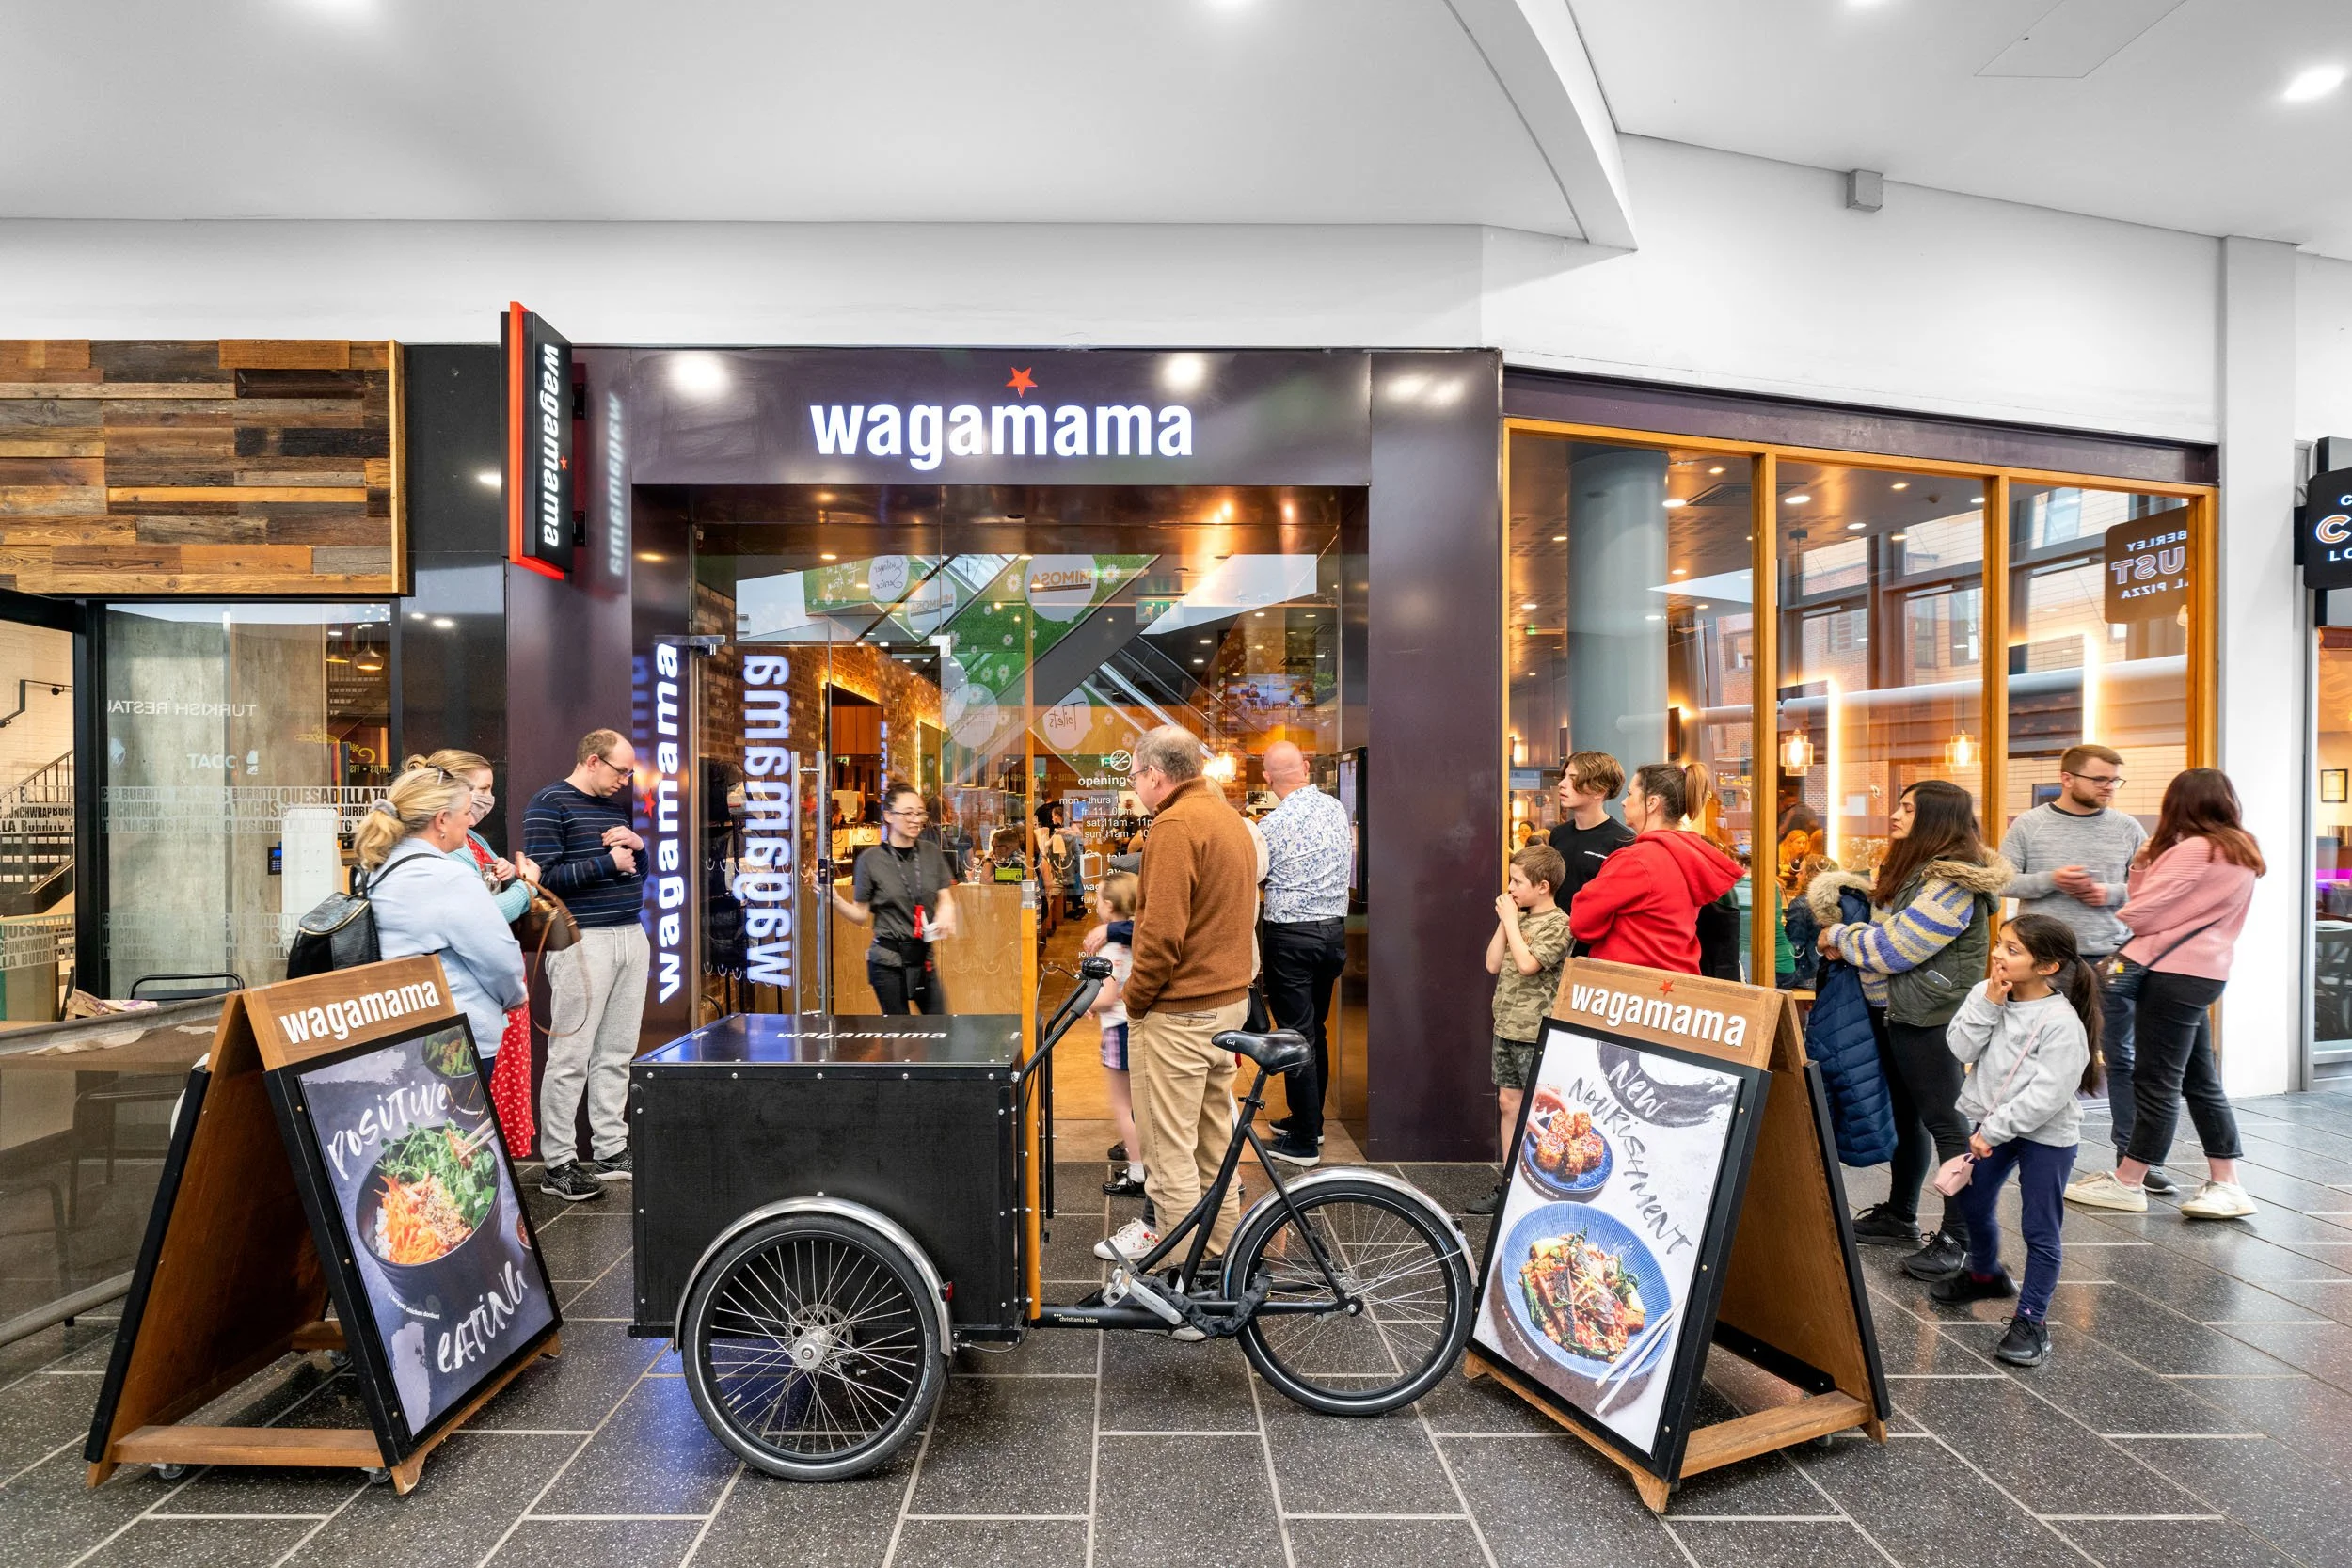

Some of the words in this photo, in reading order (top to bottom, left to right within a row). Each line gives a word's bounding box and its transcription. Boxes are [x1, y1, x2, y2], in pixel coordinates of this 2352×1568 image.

[540, 343, 559, 546] wagamama
[809, 404, 1193, 470] wagamama
[1077, 774, 1127, 788] opening
[231, 787, 278, 800] BURRITO
[280, 787, 372, 804] QUESADILLA
[1059, 797, 1079, 805] mon
[1088, 796, 1111, 804] thurs
[233, 800, 279, 817] TACOS
[656, 642, 685, 1004] wagamama
[1086, 818, 1101, 827] sat
[1103, 817, 1128, 827] 11am
[278, 979, 440, 1044] wagamama
[1570, 984, 1747, 1047] wagamama
[776, 1031, 948, 1040] wagamama
